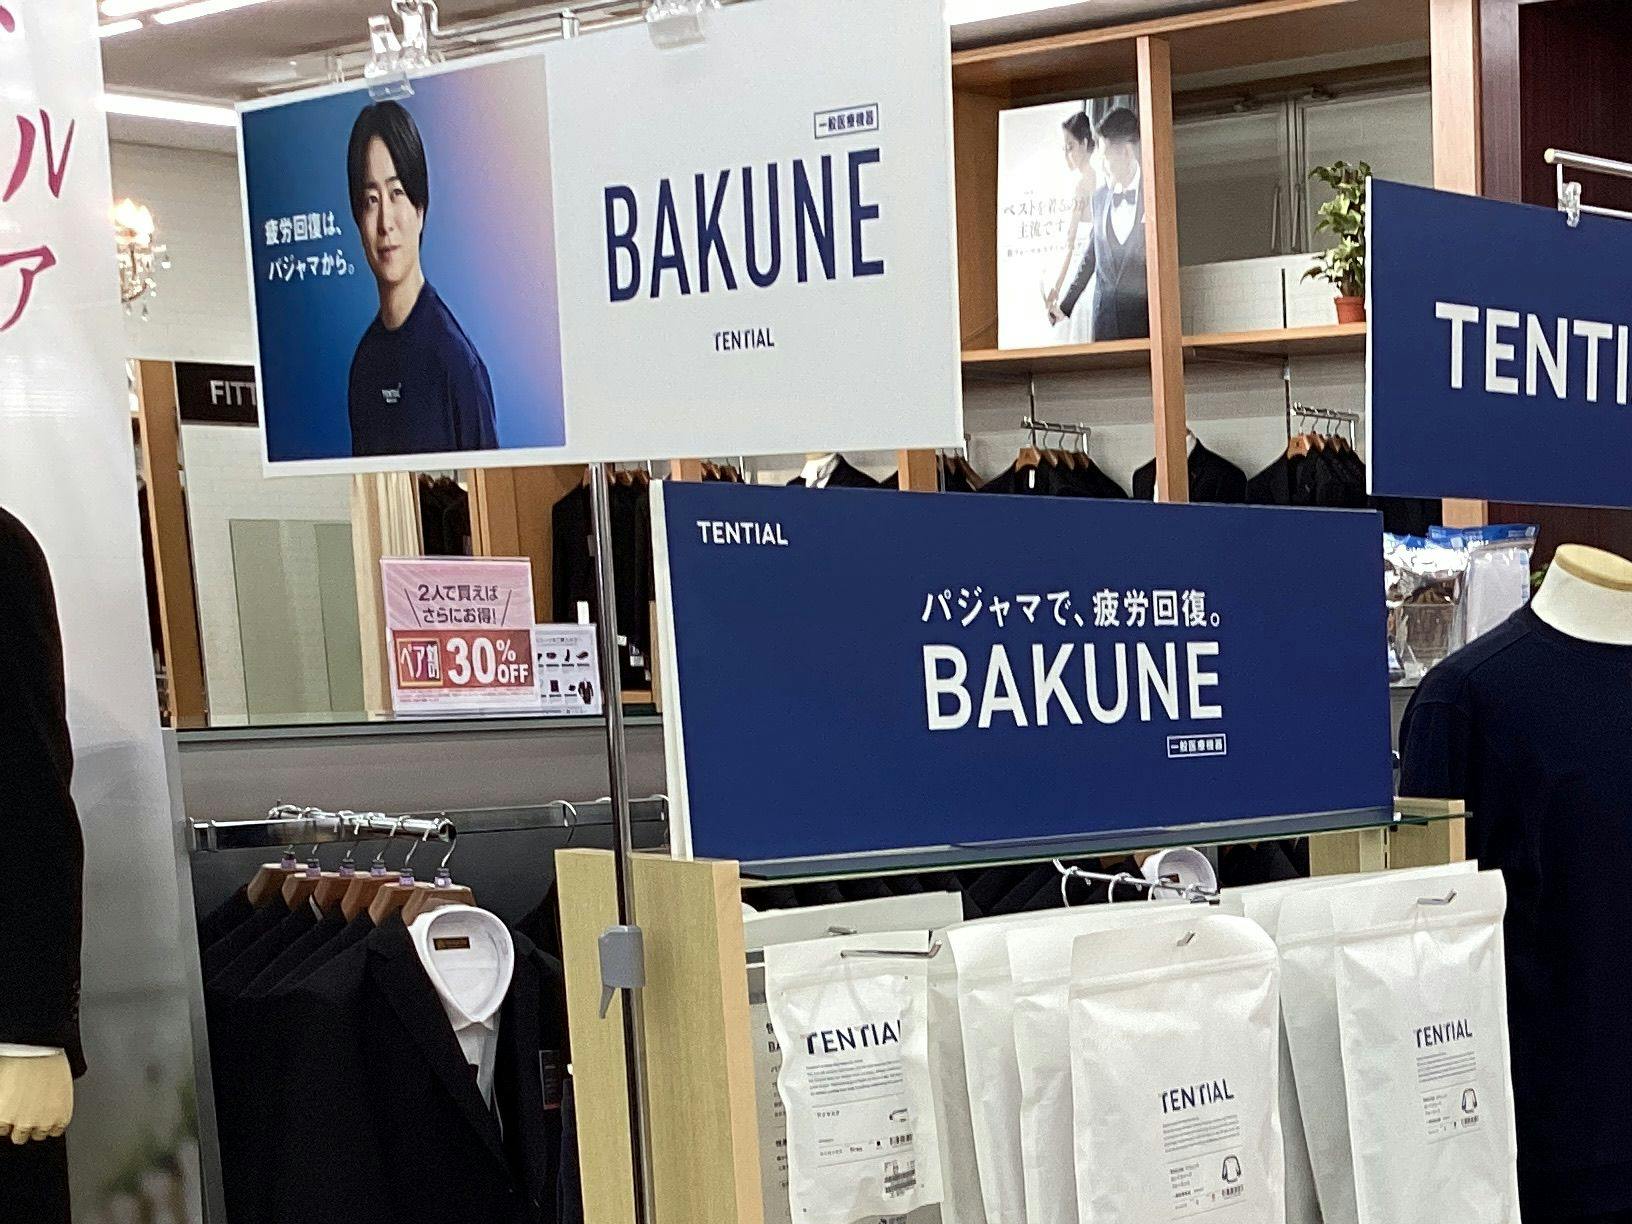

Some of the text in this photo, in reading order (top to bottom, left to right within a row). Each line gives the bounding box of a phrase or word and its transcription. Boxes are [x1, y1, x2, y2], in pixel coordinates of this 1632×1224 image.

[264, 210, 343, 247] 疲労回復は、
[604, 147, 884, 302] BAKUNE
[268, 248, 355, 283] パジャマから。
[714, 327, 775, 351] TENTIAL
[696, 519, 789, 546] TENTIAL
[418, 584, 499, 602] 2人で買えば
[921, 585, 1220, 628] パジャマで、疲労回復。
[497, 663, 530, 684] OFF
[922, 641, 1223, 731] BAKUNE
[1413, 1017, 1473, 1049] TENTIAL
[1160, 1078, 1235, 1114] TENTIAL
